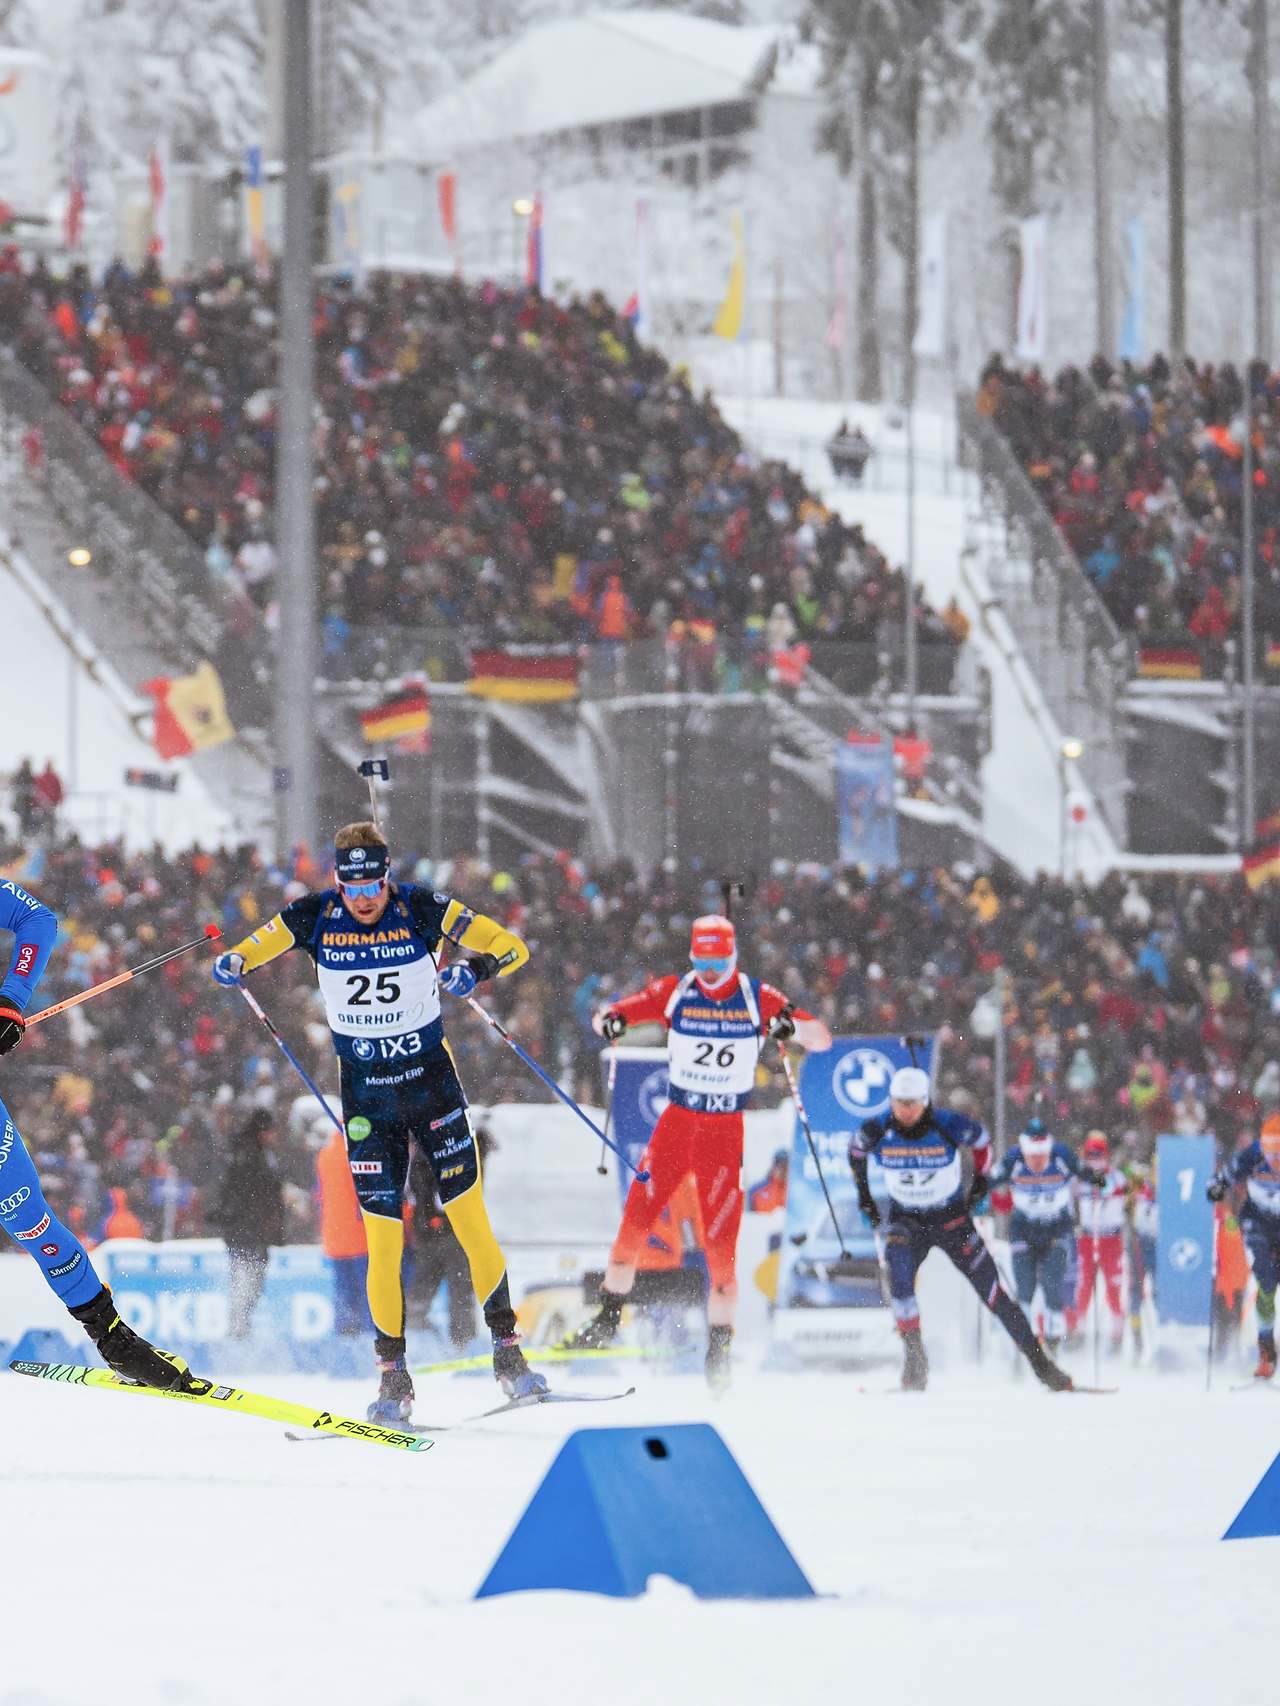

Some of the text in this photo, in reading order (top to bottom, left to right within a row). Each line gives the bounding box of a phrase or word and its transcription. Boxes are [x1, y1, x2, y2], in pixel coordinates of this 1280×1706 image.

[1, 881, 42, 911] Audi
[323, 944, 415, 961] Tore Türen
[346, 971, 400, 1005] 25
[338, 1011, 404, 1025] OBERHOF
[380, 1032, 422, 1058] iX3
[693, 1042, 735, 1068] 26
[366, 1066, 425, 1086] Monitor ERP
[335, 1421, 418, 1448] FISCHER
